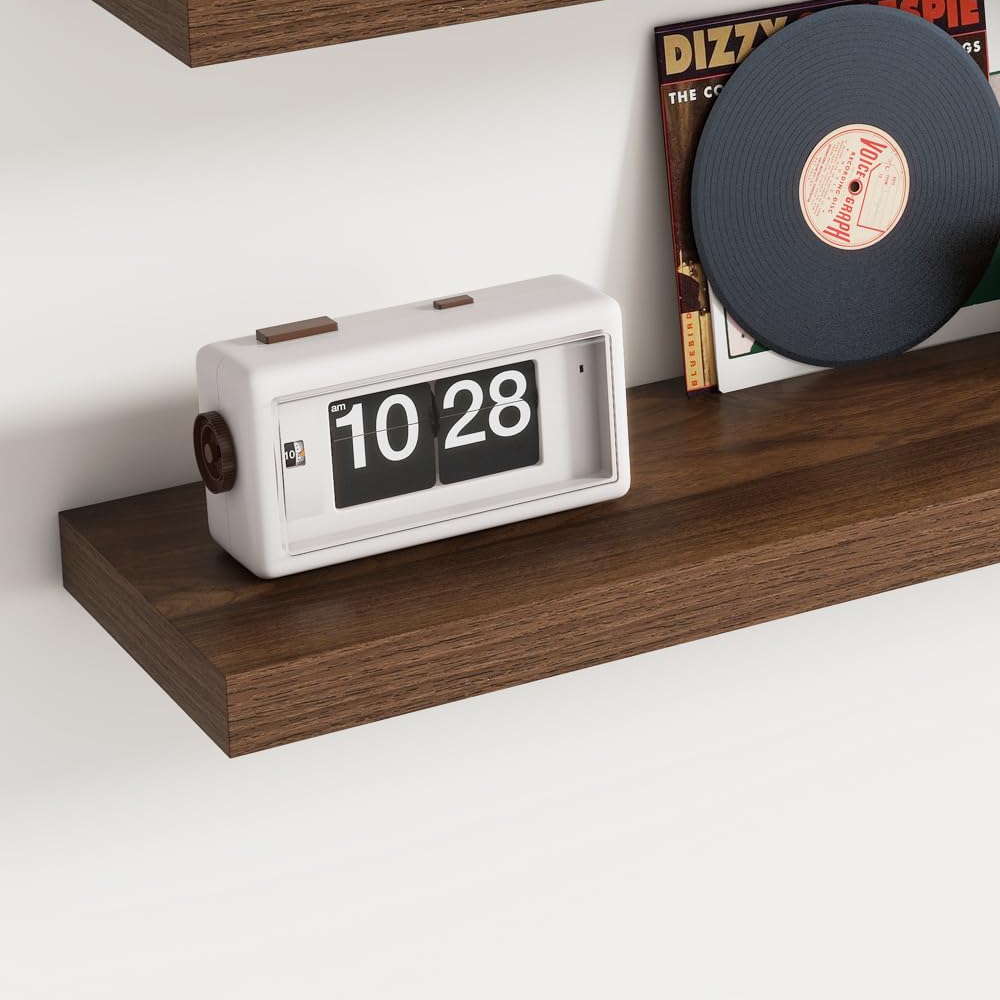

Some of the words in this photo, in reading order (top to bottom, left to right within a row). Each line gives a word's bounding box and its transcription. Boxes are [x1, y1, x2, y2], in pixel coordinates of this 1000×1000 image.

[668, 88, 697, 105] THE
[835, 151, 856, 195] RECORDING
[856, 137, 888, 178] VOICE
[822, 196, 855, 243] GRAPH
[828, 197, 838, 214] DISC
[686, 313, 698, 386] BLUEBIRD
[330, 403, 346, 412] am
[334, 393, 419, 469] 10
[442, 369, 532, 450] 28
[284, 450, 296, 460] 10
